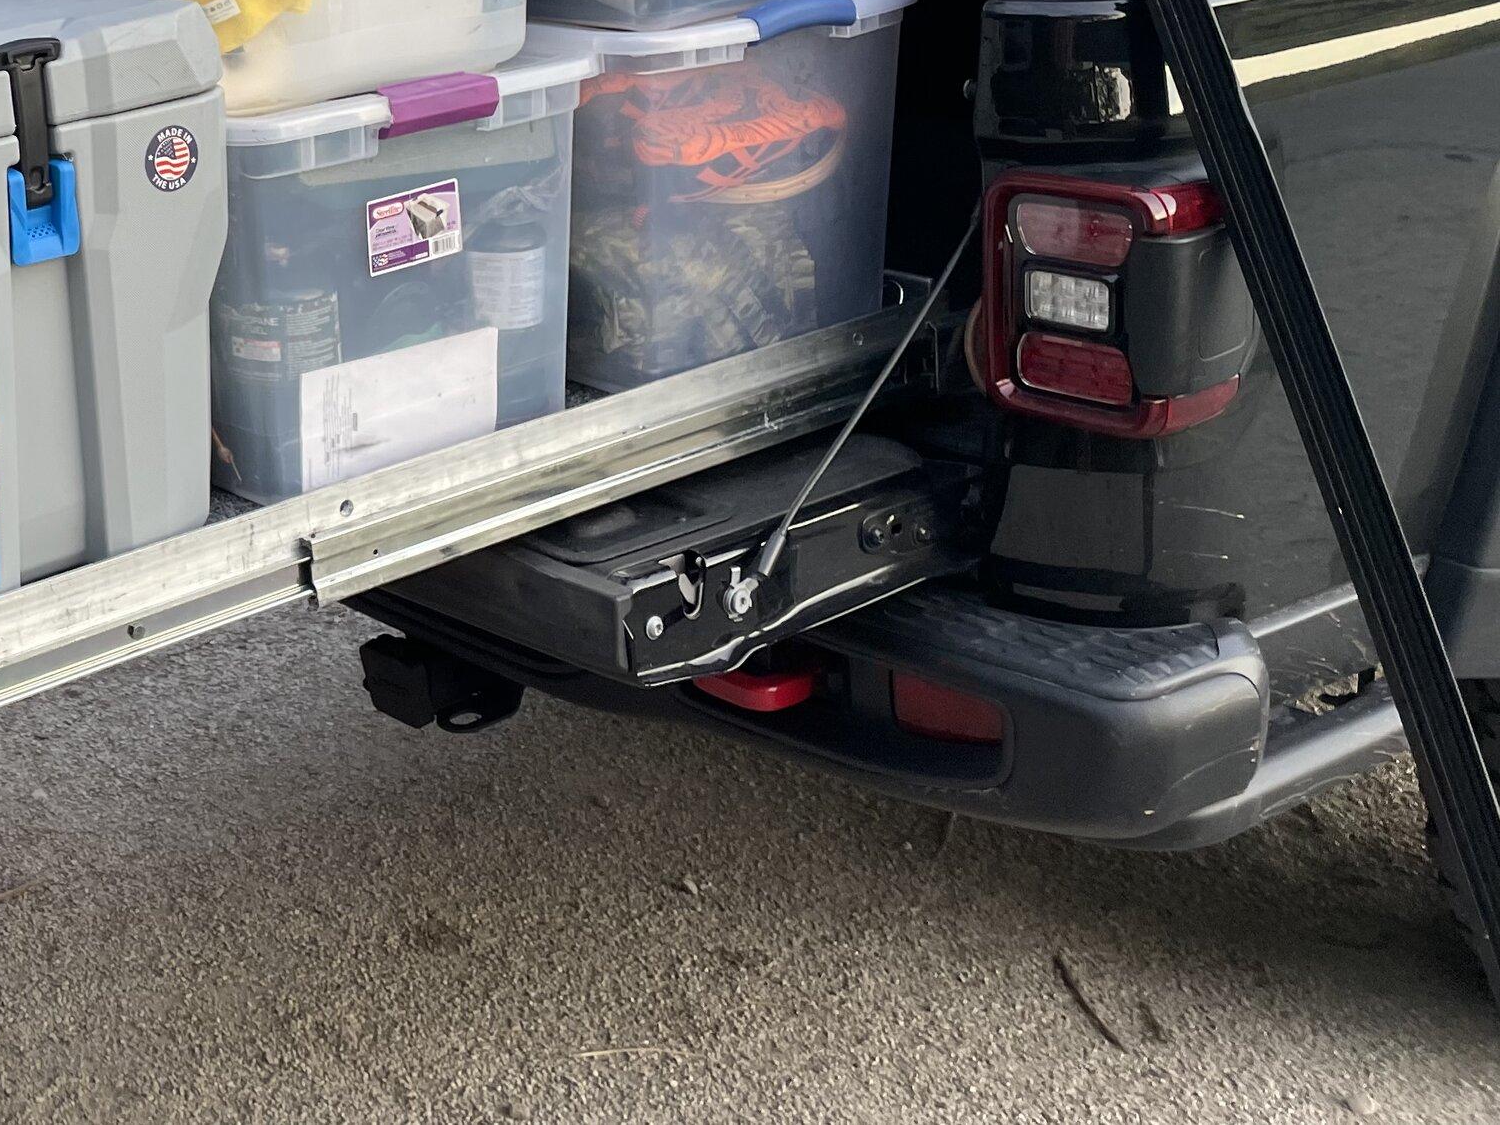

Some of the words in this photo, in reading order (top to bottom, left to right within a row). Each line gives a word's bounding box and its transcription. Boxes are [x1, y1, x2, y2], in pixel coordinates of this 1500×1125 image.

[157, 127, 183, 142] MADE
[183, 132, 192, 144] IN
[152, 174, 168, 190] THE
[168, 177, 186, 190] USA
